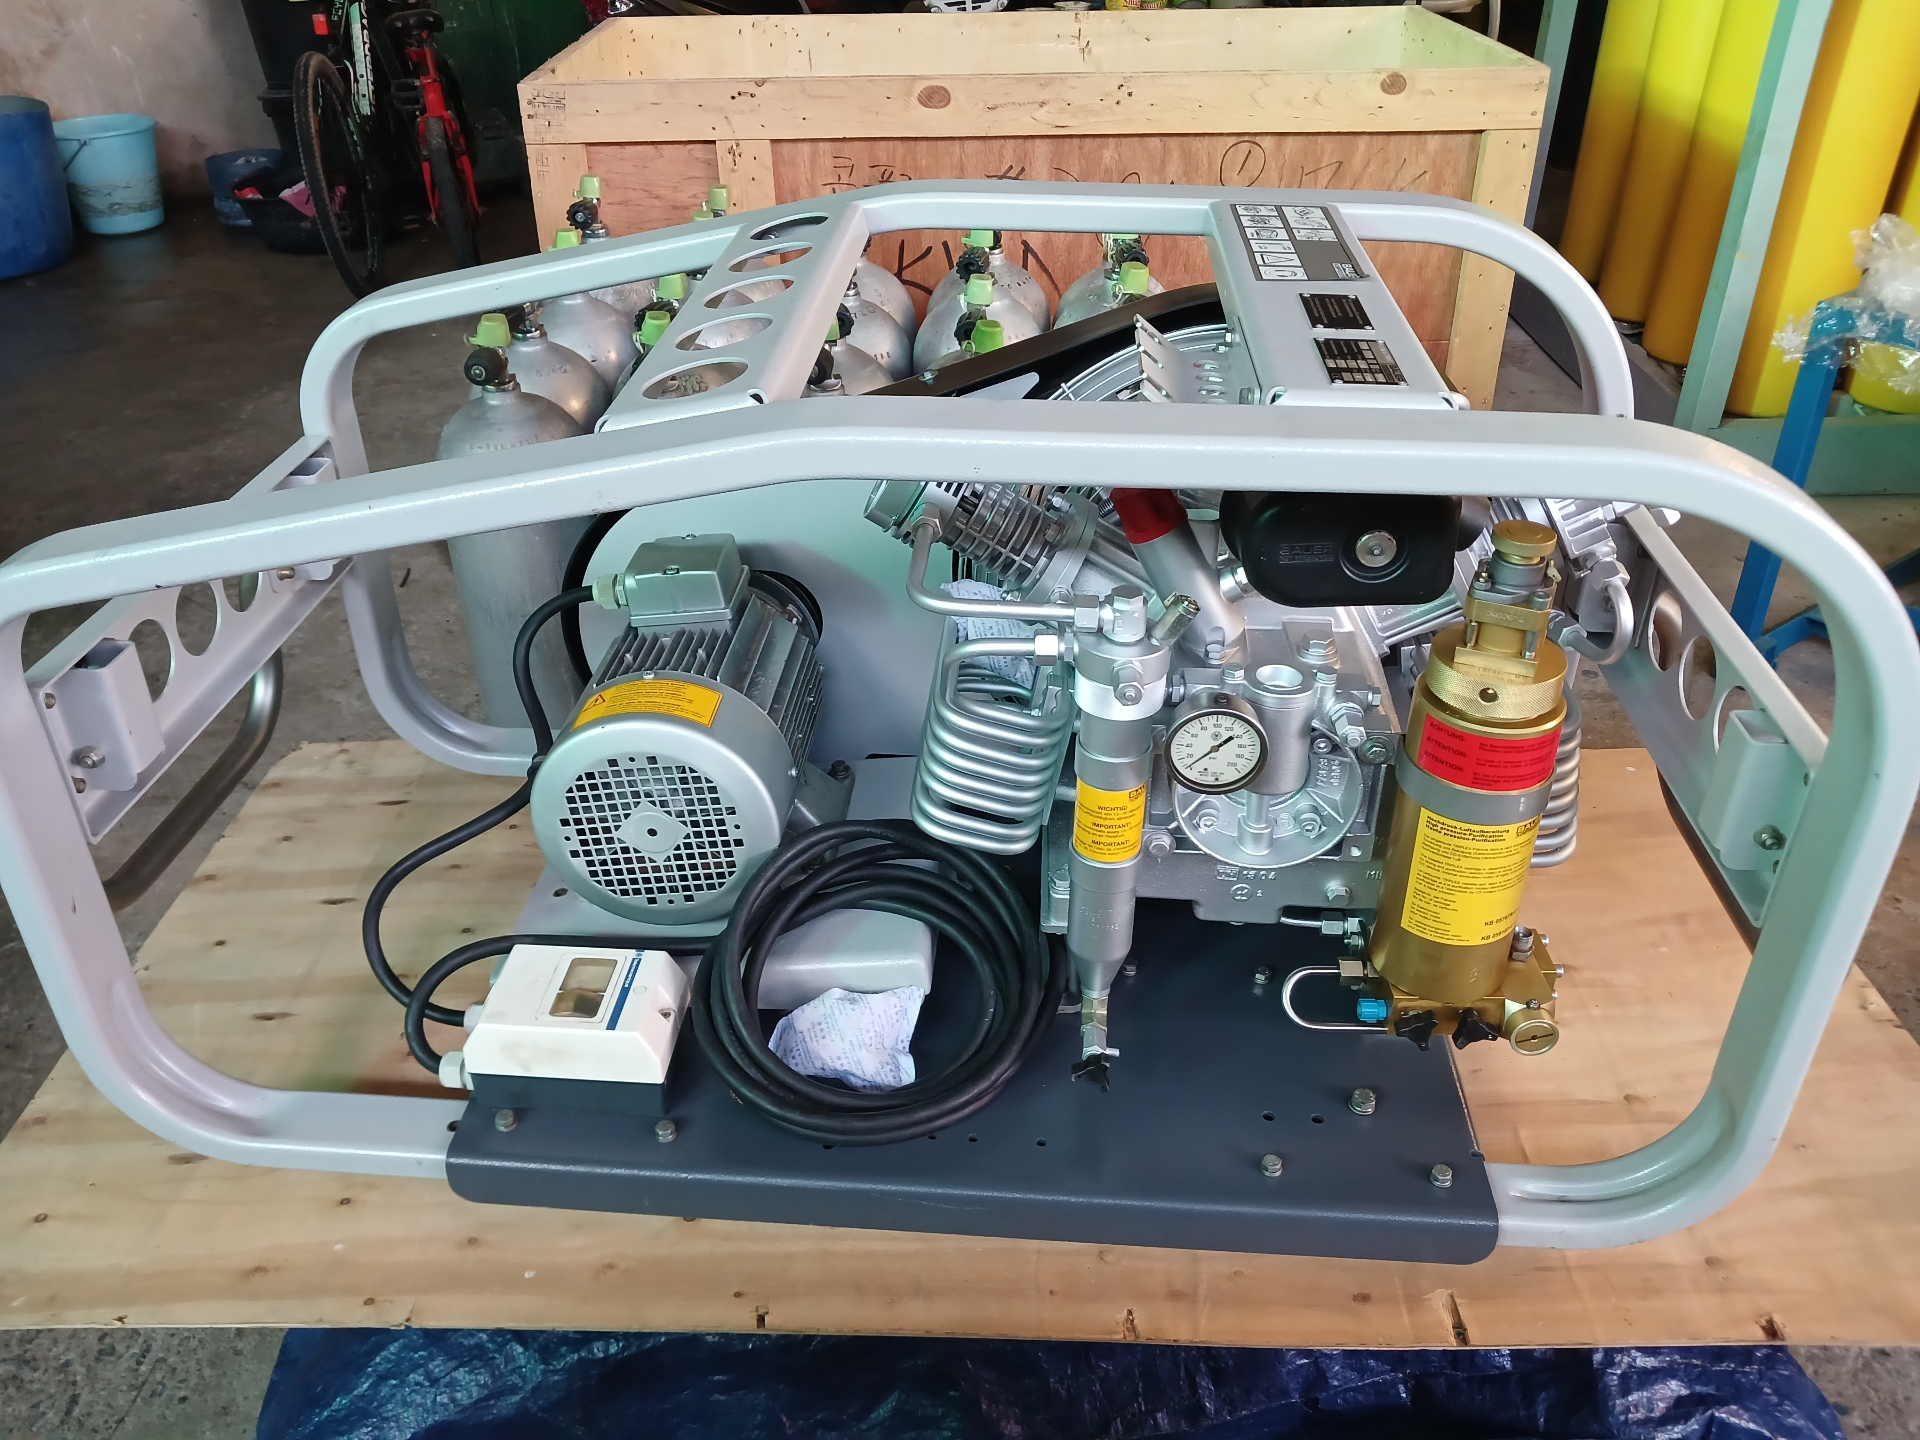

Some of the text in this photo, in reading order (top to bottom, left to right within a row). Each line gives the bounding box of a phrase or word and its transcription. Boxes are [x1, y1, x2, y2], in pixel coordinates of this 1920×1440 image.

[1429, 722, 1466, 742] ACHTUNG:
[1426, 736, 1468, 758] ATTENTION:
[1423, 750, 1465, 773] ATTENTION:
[1091, 822, 1132, 830] IMPORTANT!
[1425, 824, 1442, 835] Haute
[1443, 831, 1506, 843] pression-Purification
[1426, 819, 1440, 830] High
[1440, 824, 1504, 838] pressure-Purification
[1091, 839, 1130, 847] IMPORTANT!
